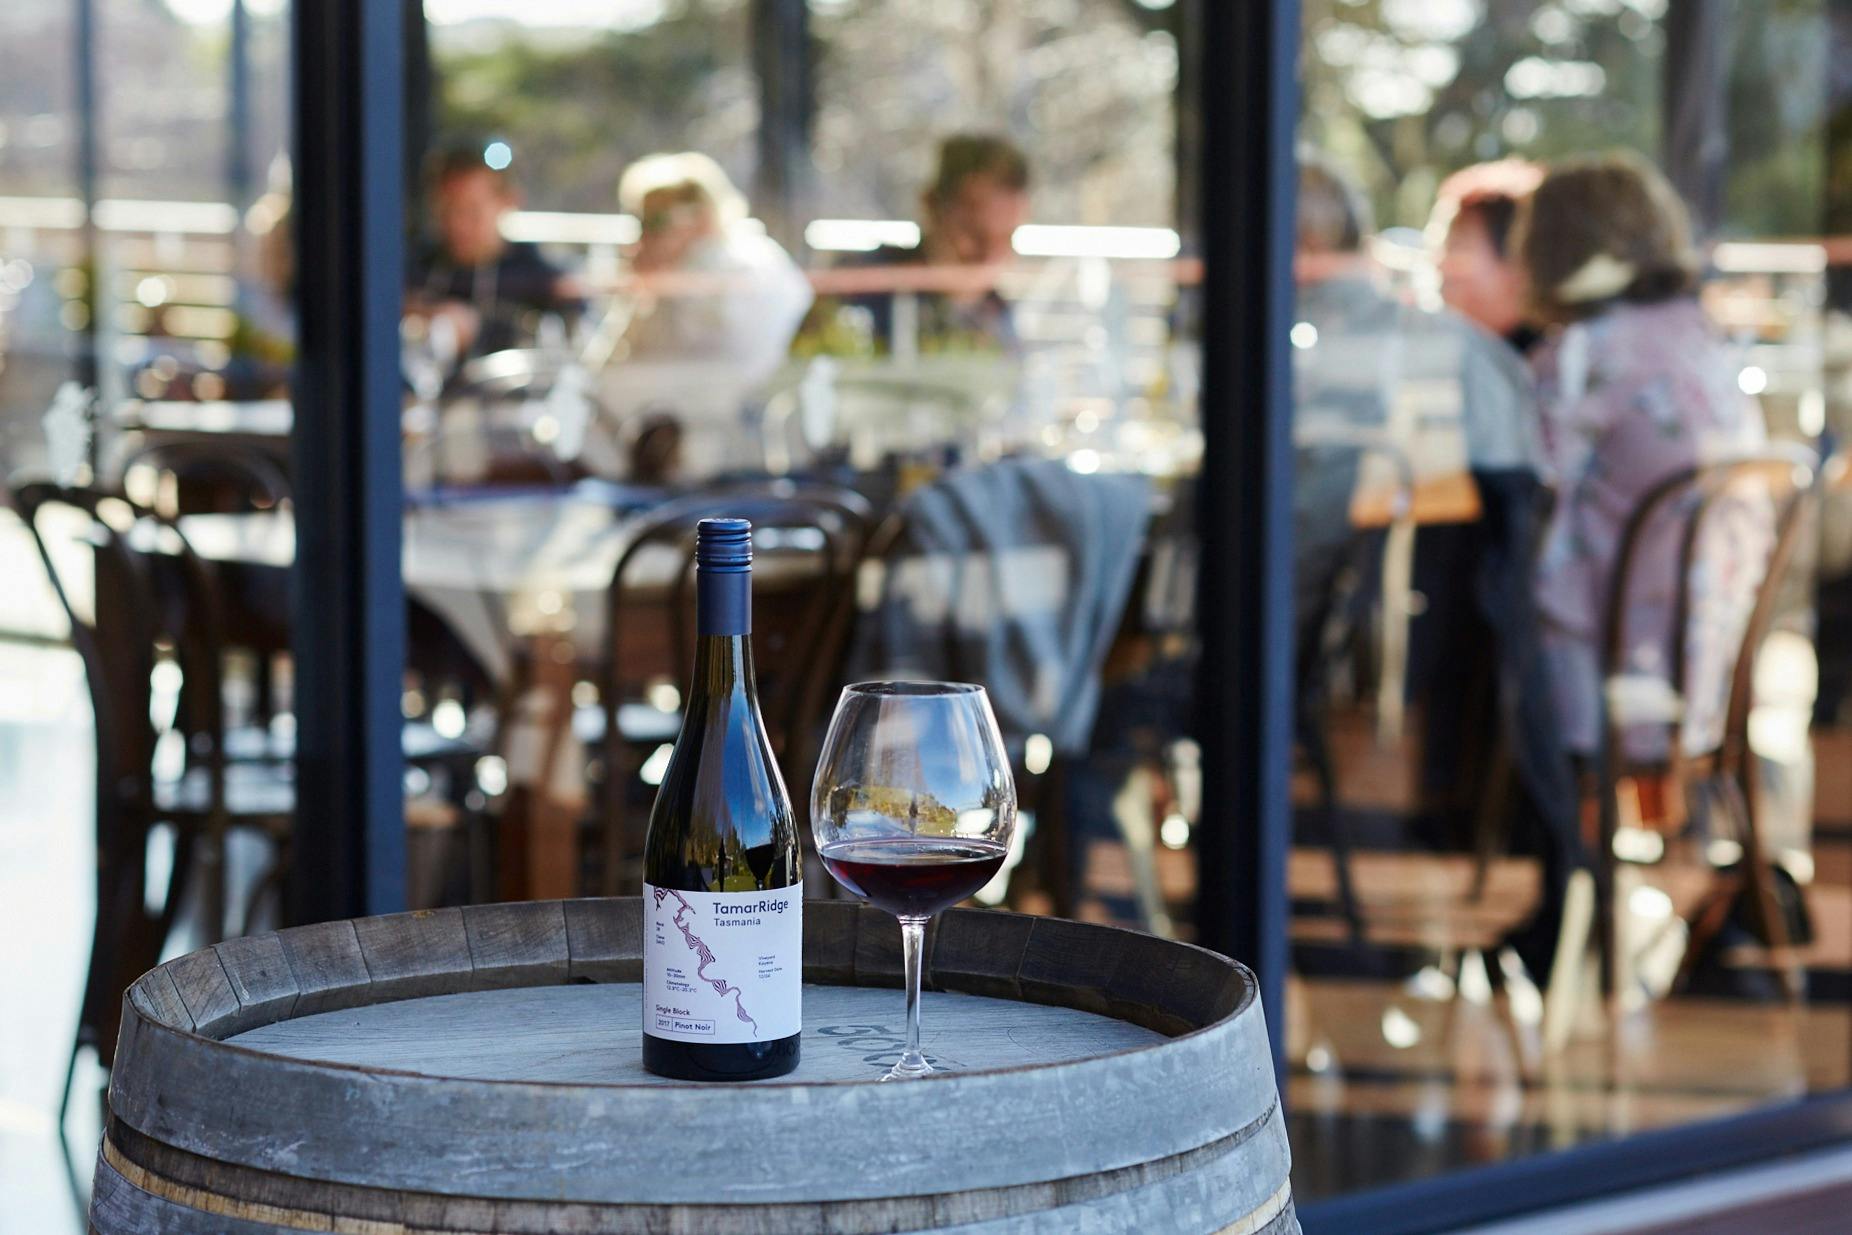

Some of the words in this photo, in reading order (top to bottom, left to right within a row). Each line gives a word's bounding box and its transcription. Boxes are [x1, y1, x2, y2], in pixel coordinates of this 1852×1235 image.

[713, 899, 789, 914] TamarRidge
[714, 917, 761, 927] Tasmania
[656, 1004, 671, 1014] Single
[672, 1007, 690, 1016] Block
[658, 1019, 670, 1027] 2017
[674, 1021, 693, 1030] Pinot
[695, 1023, 711, 1031] Noir
